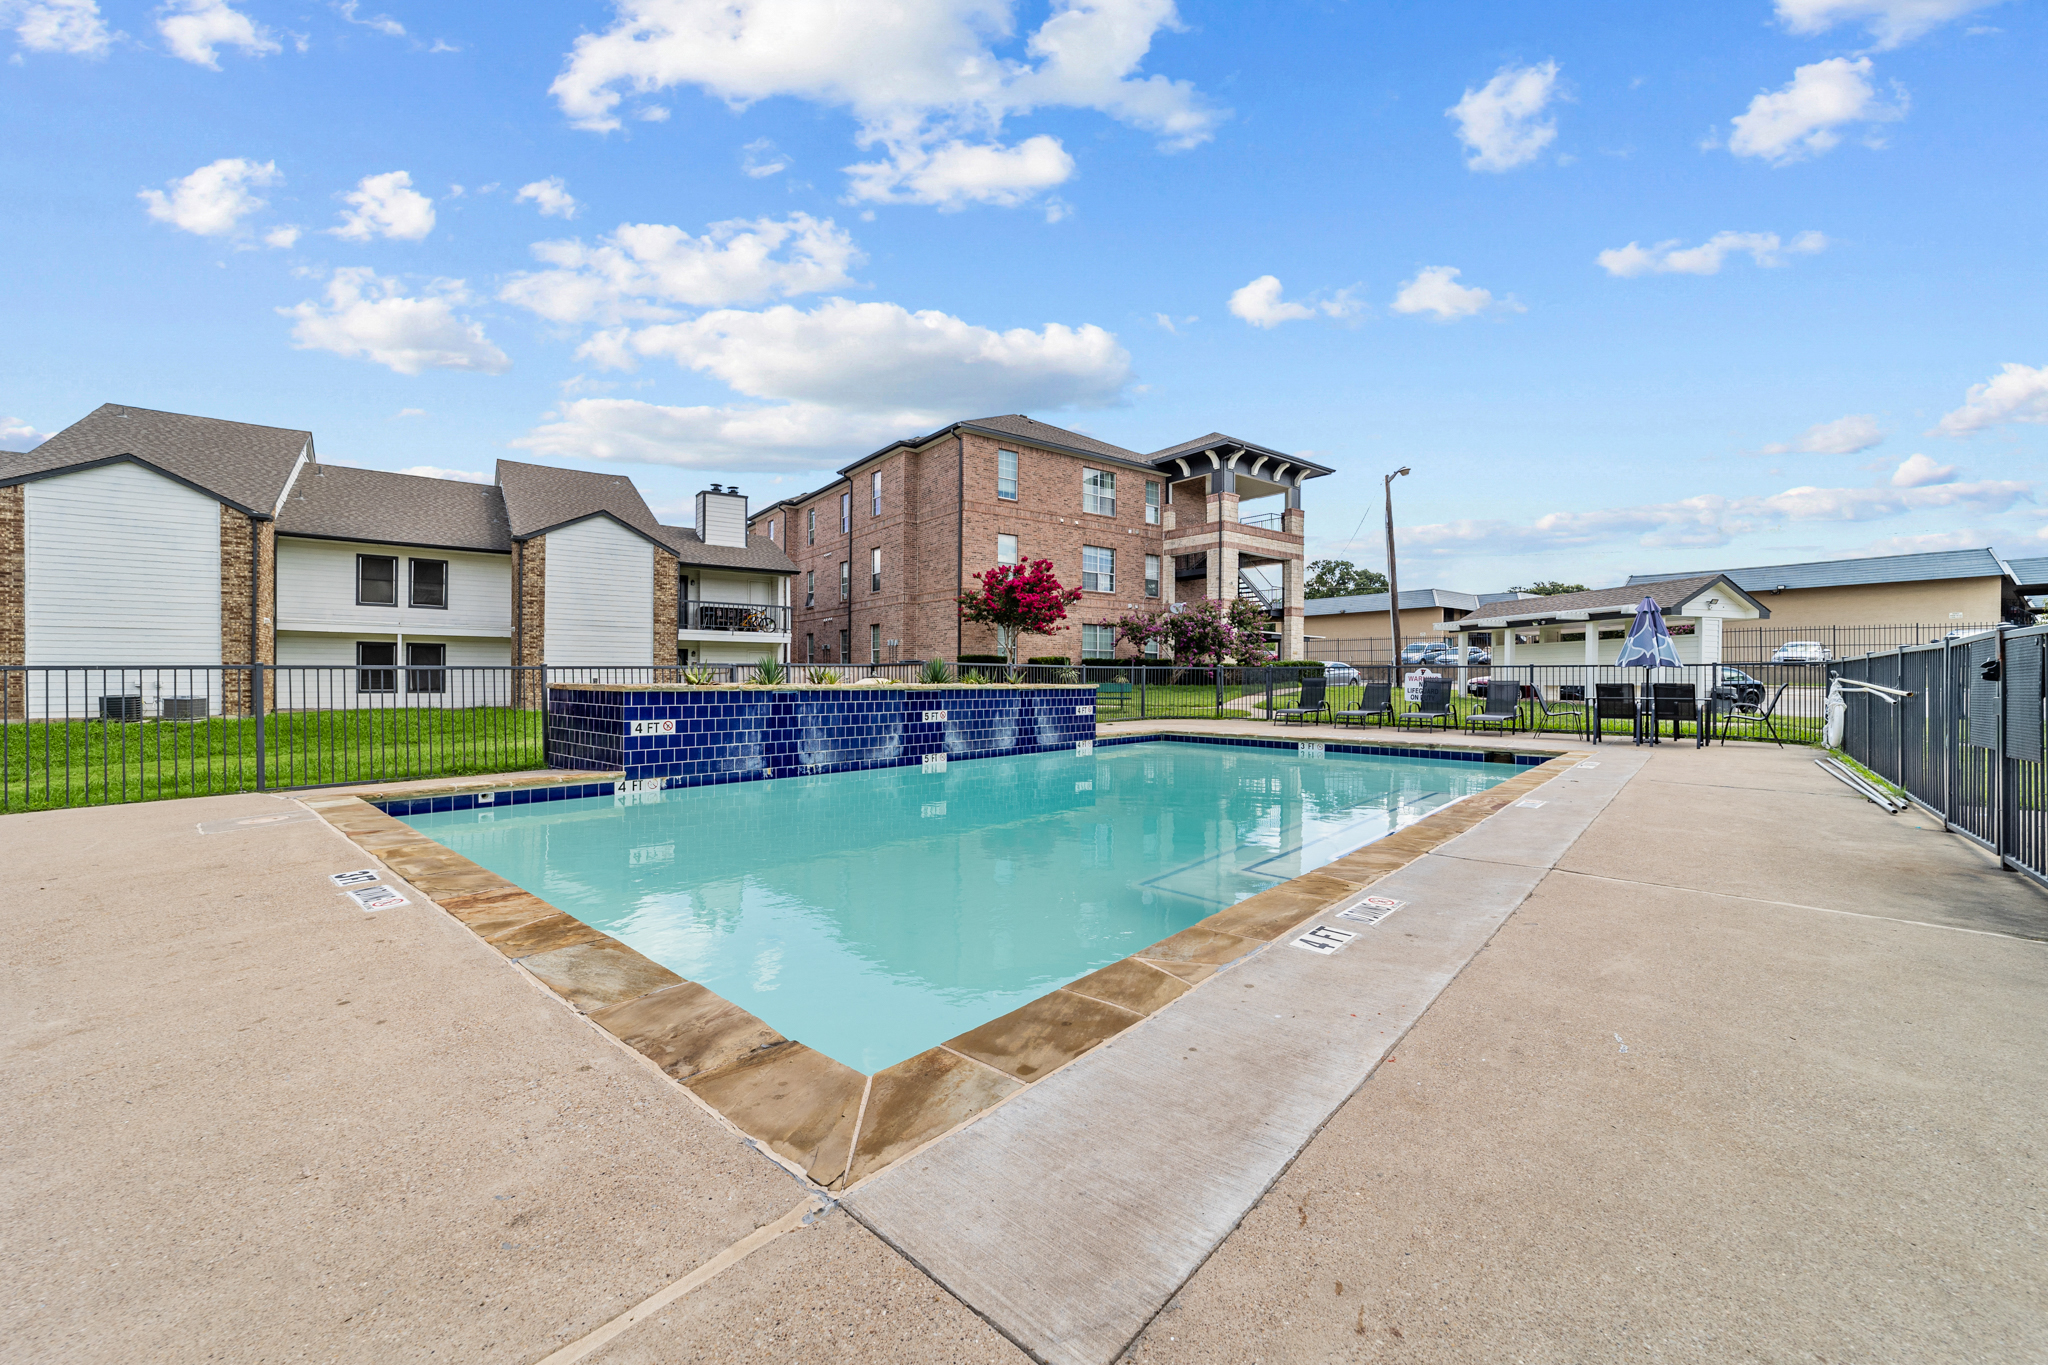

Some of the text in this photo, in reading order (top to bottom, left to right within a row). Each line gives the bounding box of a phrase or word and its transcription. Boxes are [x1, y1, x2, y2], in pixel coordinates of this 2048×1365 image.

[924, 712, 938, 720] 5 FT
[635, 722, 660, 734] 4 FT
[924, 754, 938, 762] 5 FT
[618, 780, 643, 792] 4 FT
[1299, 926, 1352, 949] 4 FT
